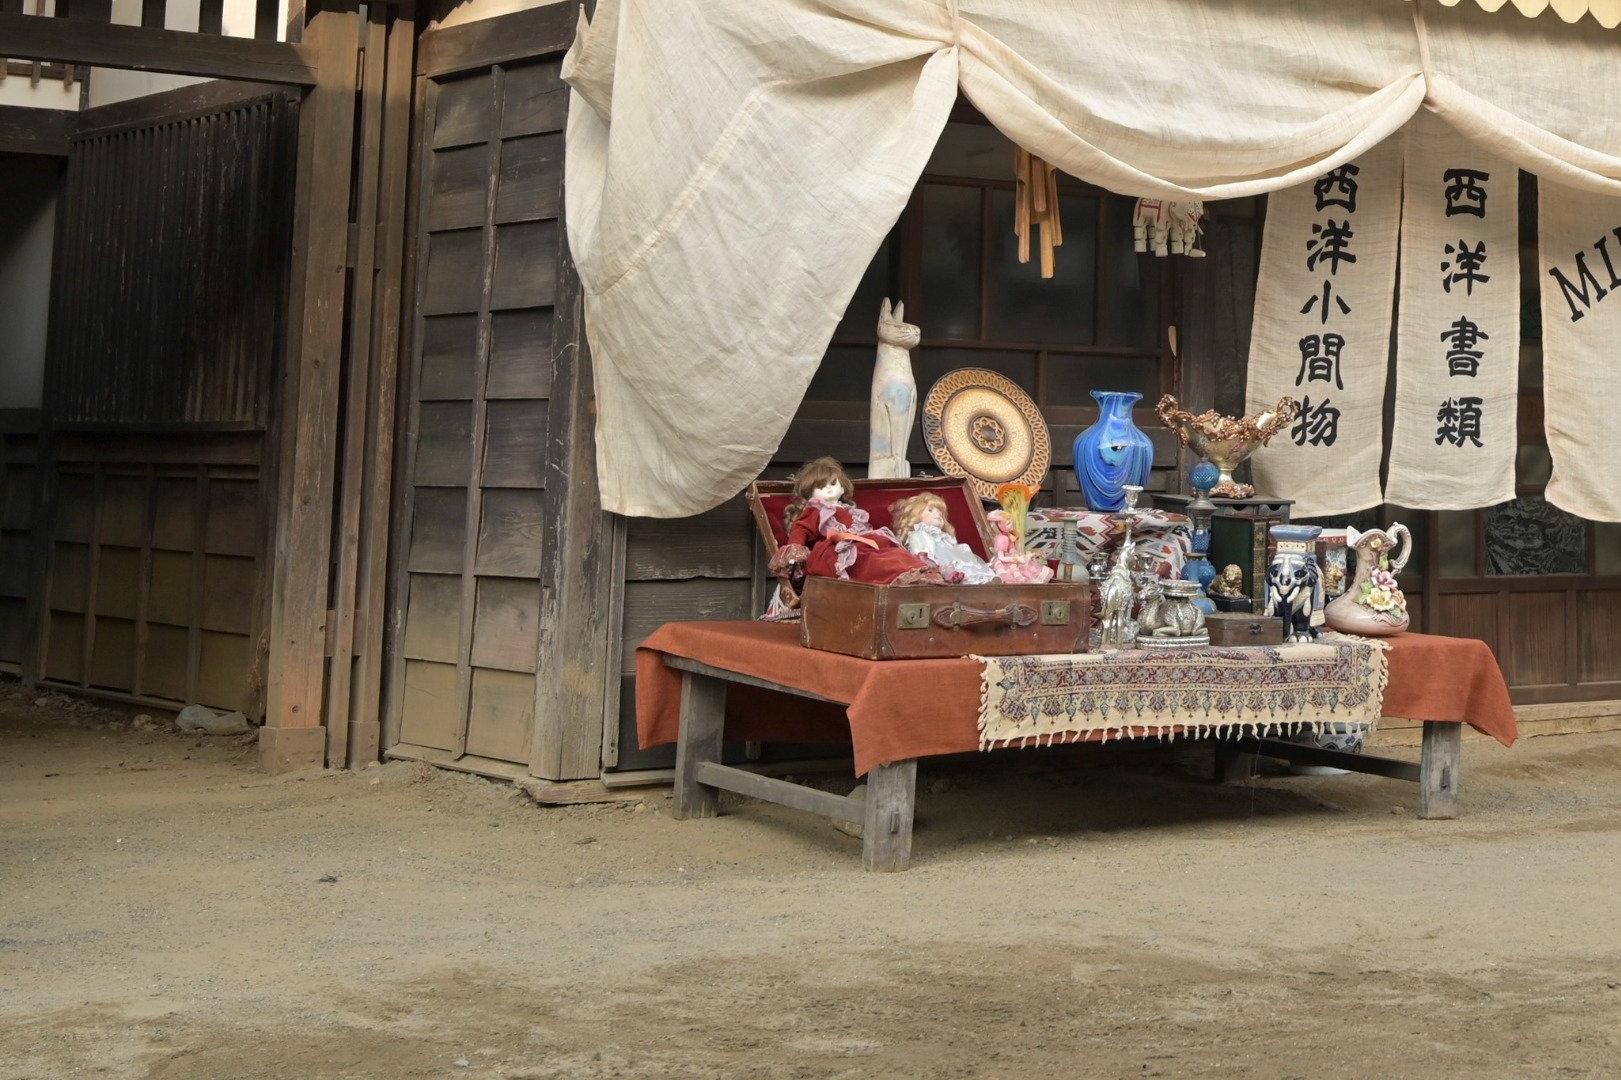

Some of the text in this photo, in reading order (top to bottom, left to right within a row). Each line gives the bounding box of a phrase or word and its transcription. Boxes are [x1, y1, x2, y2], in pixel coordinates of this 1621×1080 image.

[1290, 162, 1361, 448] 西洋小間物
